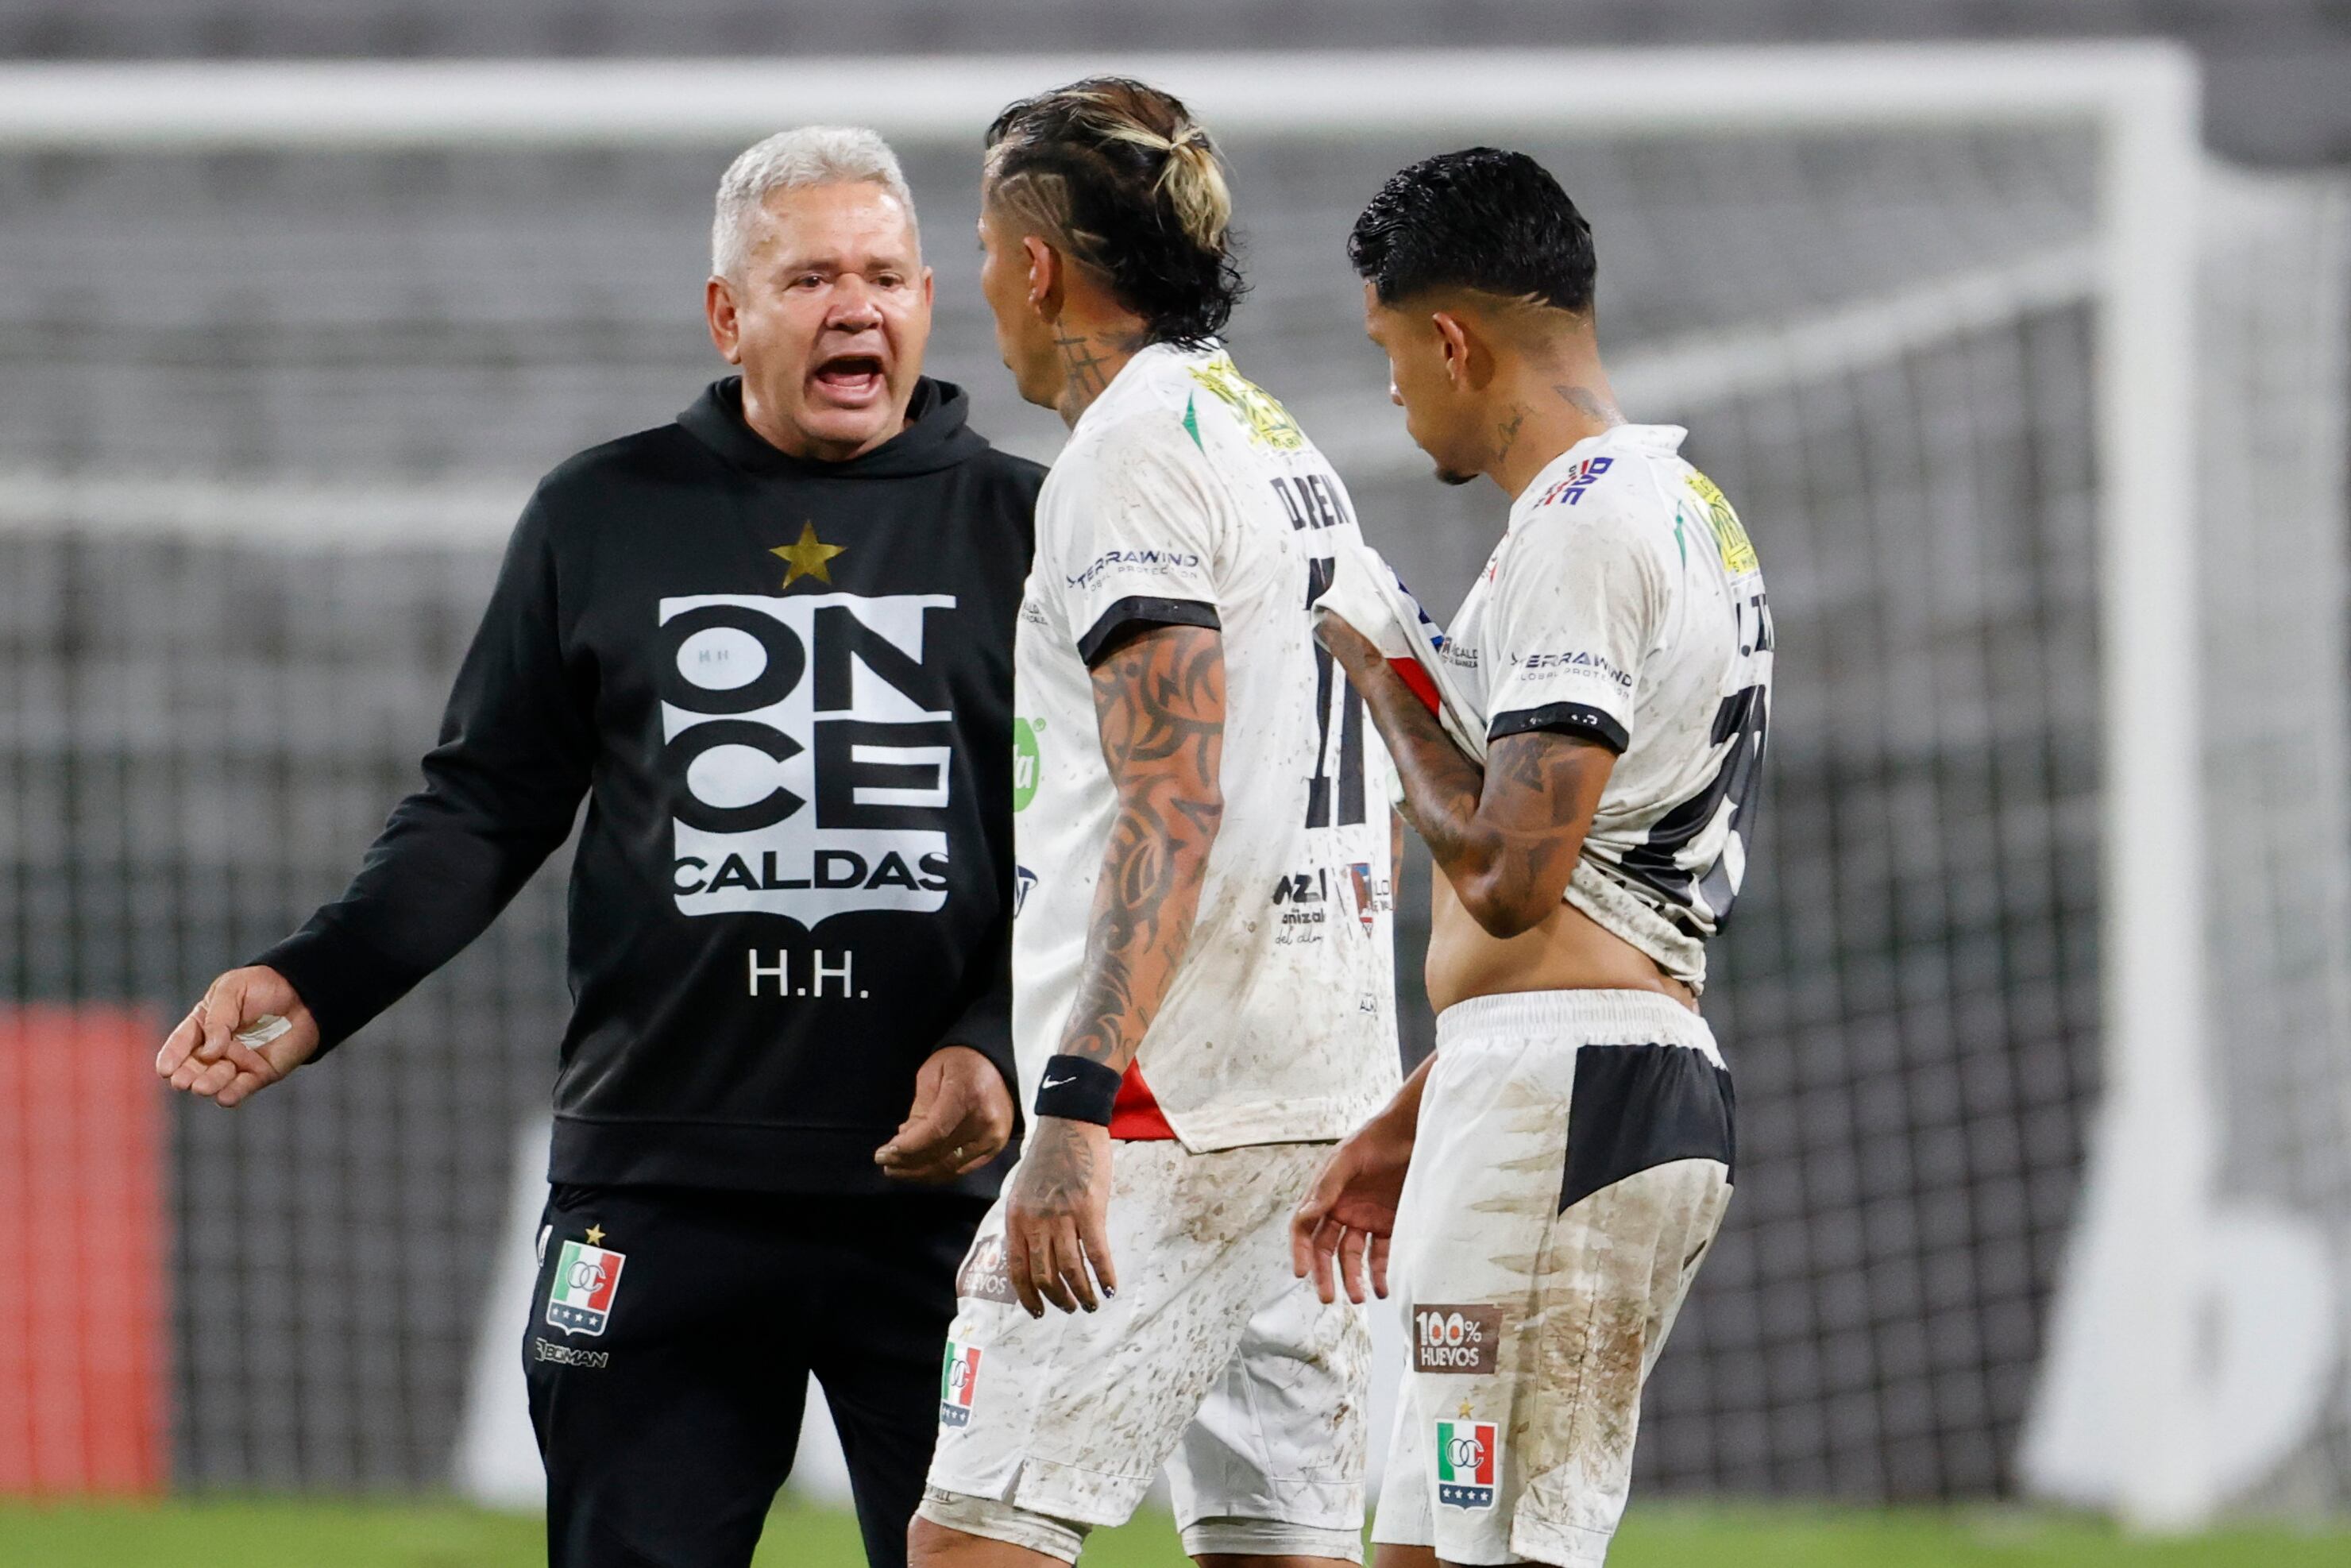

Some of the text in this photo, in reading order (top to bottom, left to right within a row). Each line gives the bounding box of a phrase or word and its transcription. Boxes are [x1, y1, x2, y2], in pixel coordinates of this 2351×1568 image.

[673, 850, 950, 896] CALDAS
[749, 948, 869, 998] H.H.
[1415, 1311, 1481, 1346] 100%
[1421, 1347, 1479, 1366] HUEVOS
